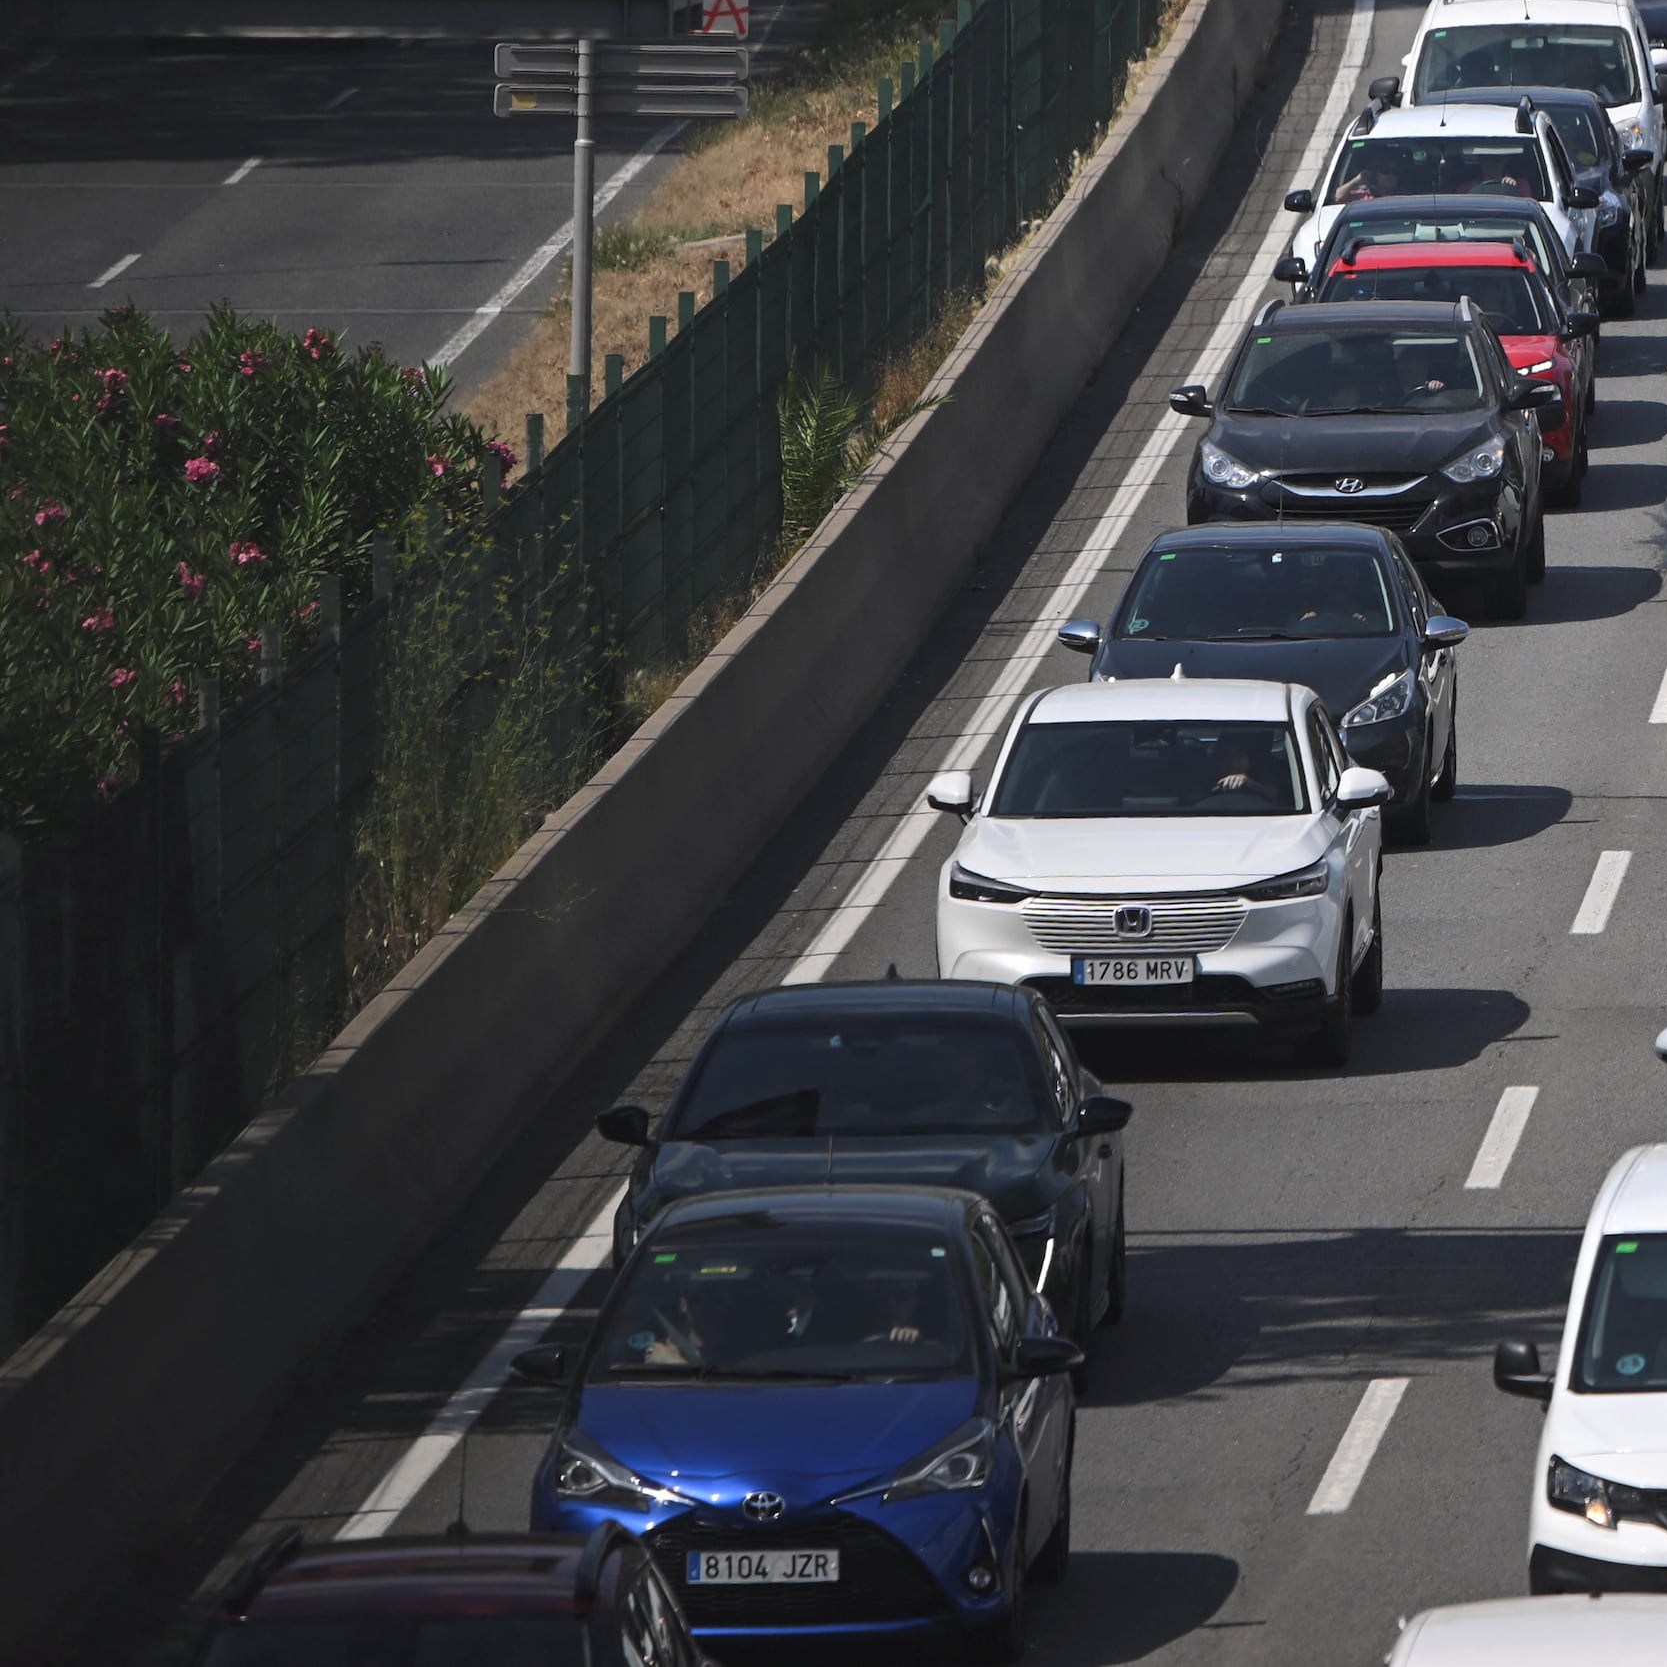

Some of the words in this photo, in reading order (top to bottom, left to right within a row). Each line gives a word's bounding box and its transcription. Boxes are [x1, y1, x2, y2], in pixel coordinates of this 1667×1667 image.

[1087, 961, 1139, 981] 1786
[1145, 960, 1186, 980] MRV
[705, 1554, 769, 1580] 8104
[782, 1553, 830, 1578] JZR
